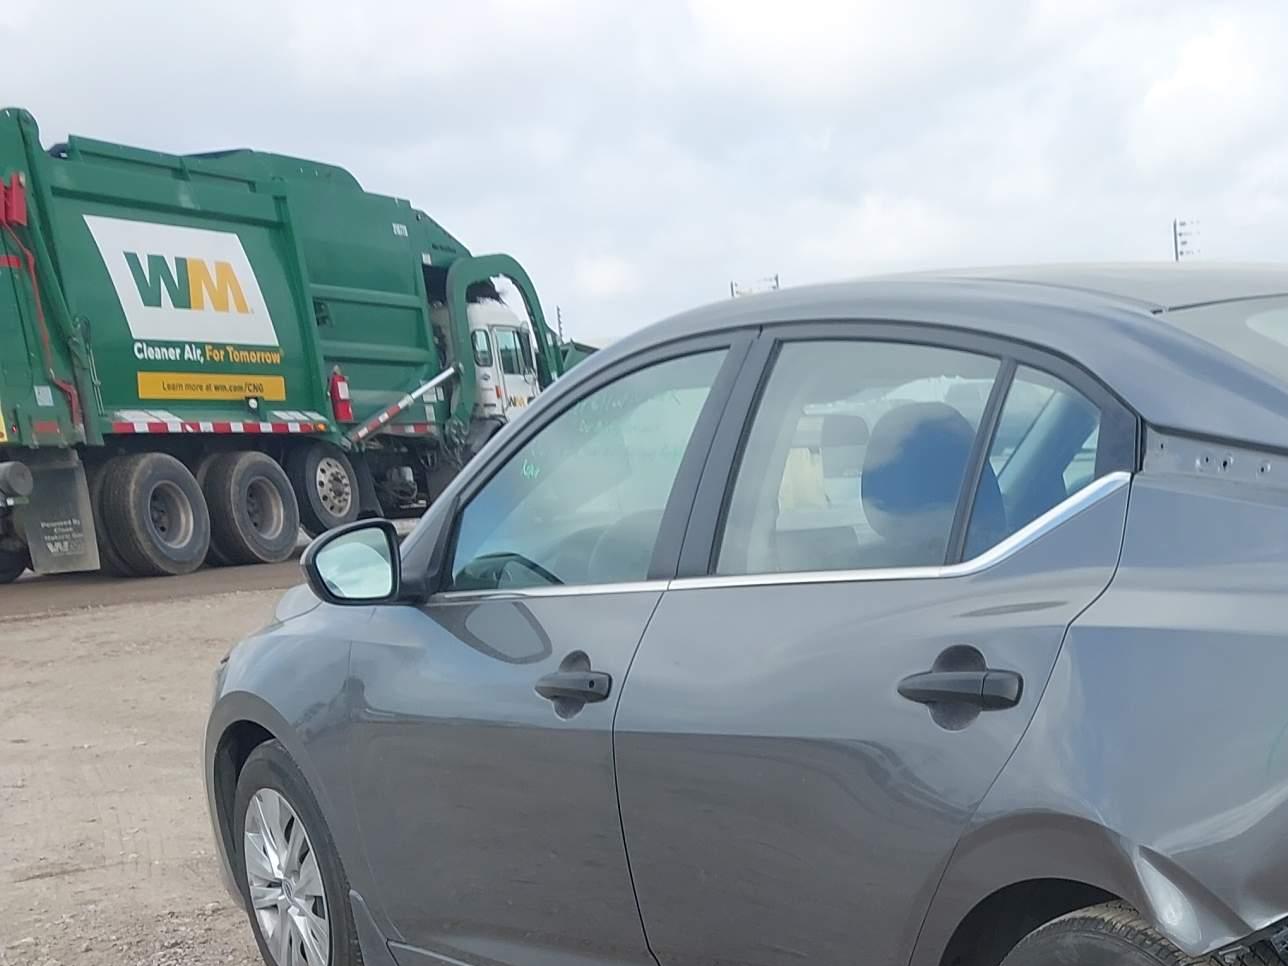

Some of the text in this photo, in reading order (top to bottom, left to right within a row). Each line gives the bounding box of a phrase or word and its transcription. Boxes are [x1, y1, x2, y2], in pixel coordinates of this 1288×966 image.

[123, 251, 249, 314] WM
[134, 342, 181, 360] Cleaner
[184, 343, 204, 364] Air,
[205, 345, 224, 362] For
[162, 381, 184, 392] Learn
[184, 383, 203, 393] more
[205, 383, 213, 393] at
